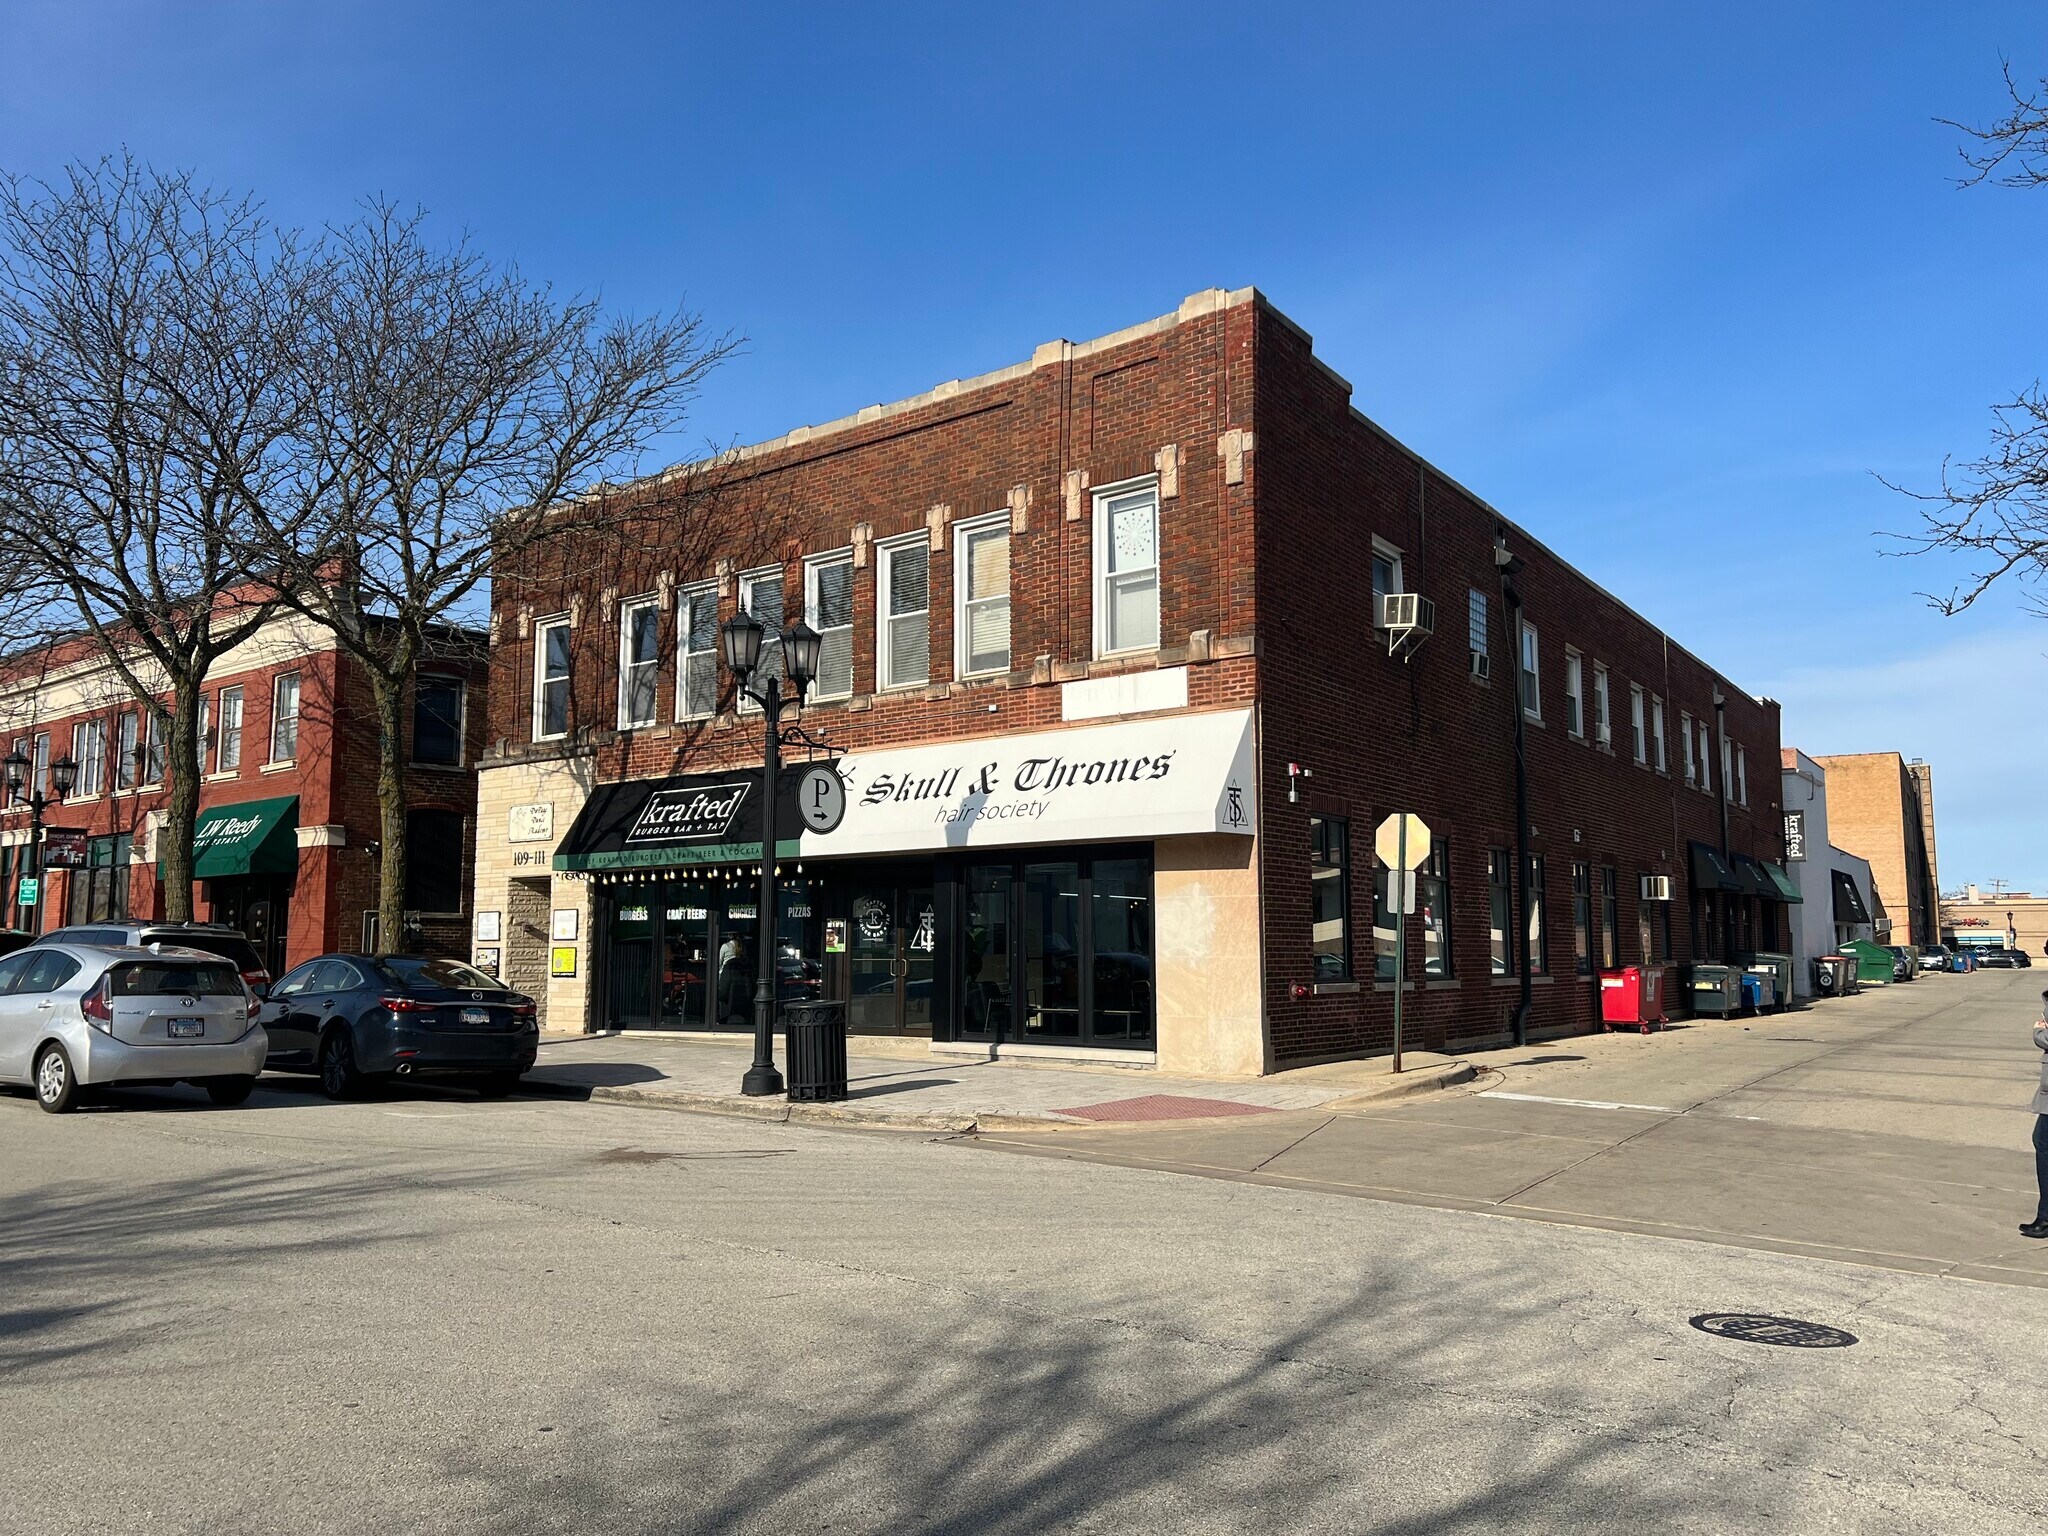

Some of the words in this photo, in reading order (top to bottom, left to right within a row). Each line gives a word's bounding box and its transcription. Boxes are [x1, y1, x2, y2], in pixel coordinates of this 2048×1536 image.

[858, 766, 964, 807] Skull
[968, 761, 1000, 796] &
[1014, 749, 1177, 796] Thrones
[812, 777, 830, 808] P
[641, 789, 742, 824] krafted
[934, 804, 975, 823] hair
[976, 799, 1051, 821] society
[196, 818, 229, 839] LW
[219, 815, 262, 838] Reedy
[635, 826, 671, 836] BURGER
[674, 824, 692, 833] BAR
[706, 821, 725, 831] TAP
[1789, 814, 1803, 858] krafted
[672, 851, 695, 859] CRAFT
[619, 910, 648, 921] BURGERS
[666, 909, 687, 920] CRAFT
[687, 908, 708, 920] BEERS
[728, 907, 757, 919] CHICKEN
[787, 906, 812, 918] PIZZAS
[870, 912, 879, 925] k
